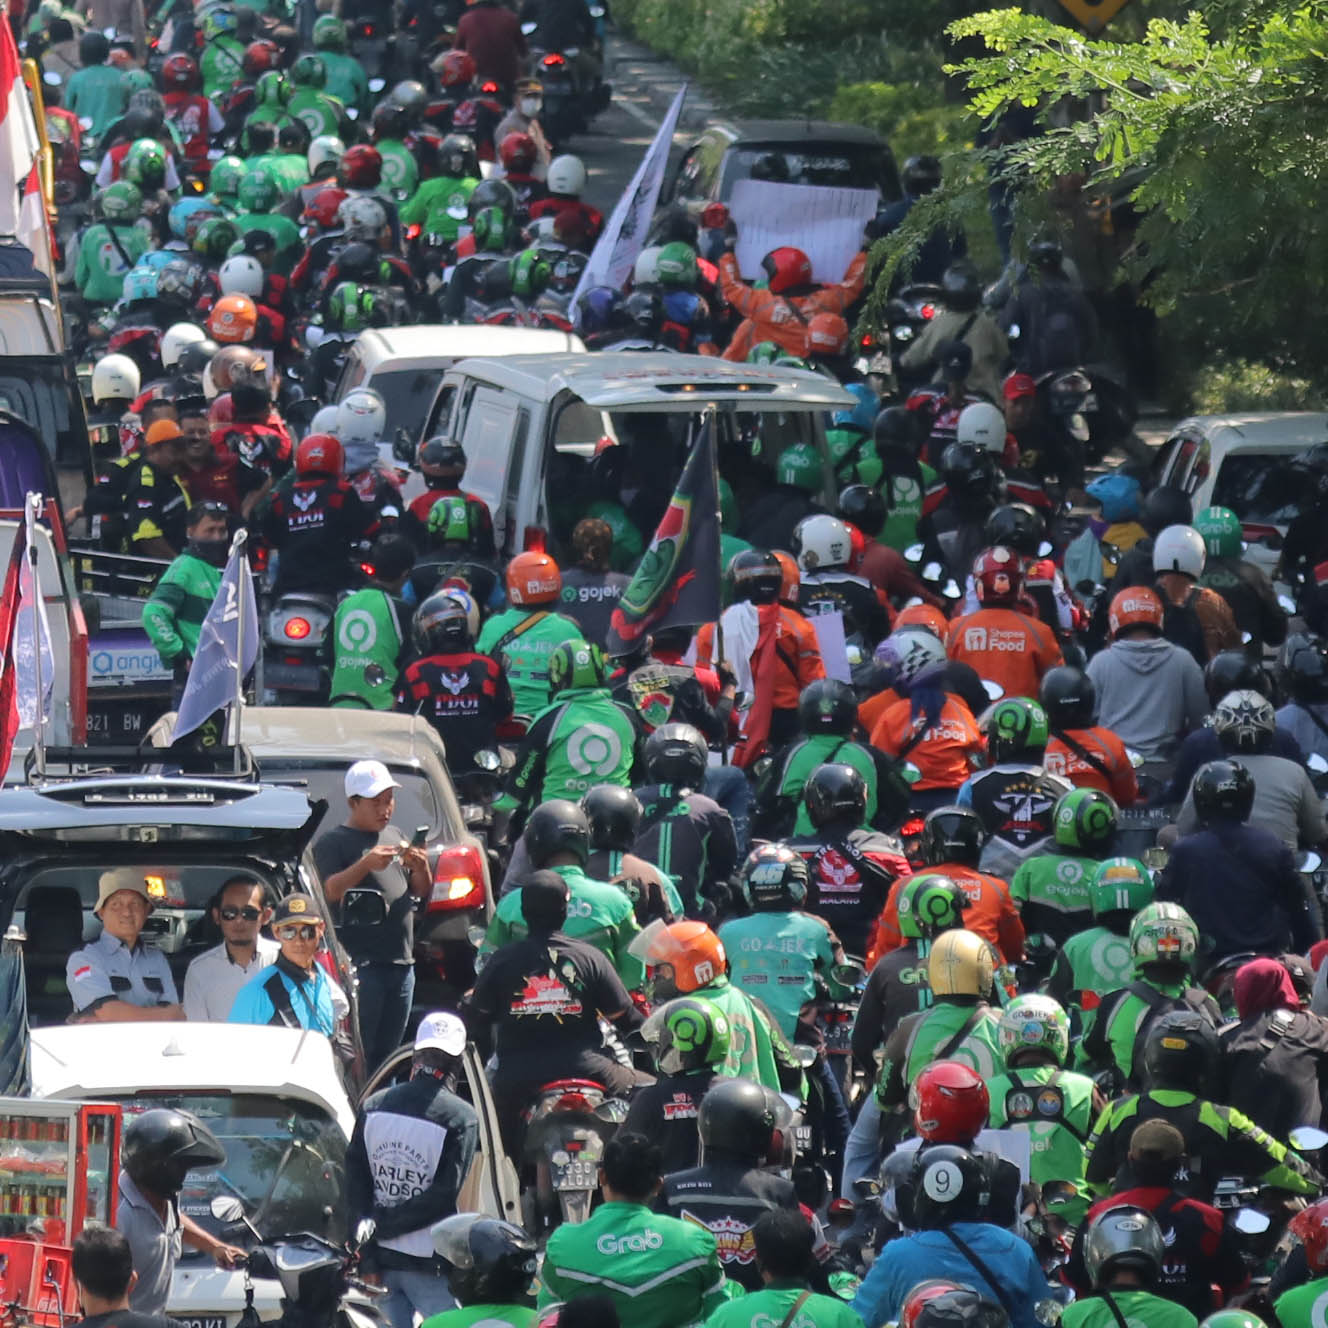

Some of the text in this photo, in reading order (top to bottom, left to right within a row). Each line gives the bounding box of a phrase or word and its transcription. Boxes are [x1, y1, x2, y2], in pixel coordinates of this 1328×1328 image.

[579, 586, 621, 602] gojek
[991, 639, 1025, 651] Food
[935, 1169, 951, 1194] 9
[597, 1228, 664, 1255] Grab
